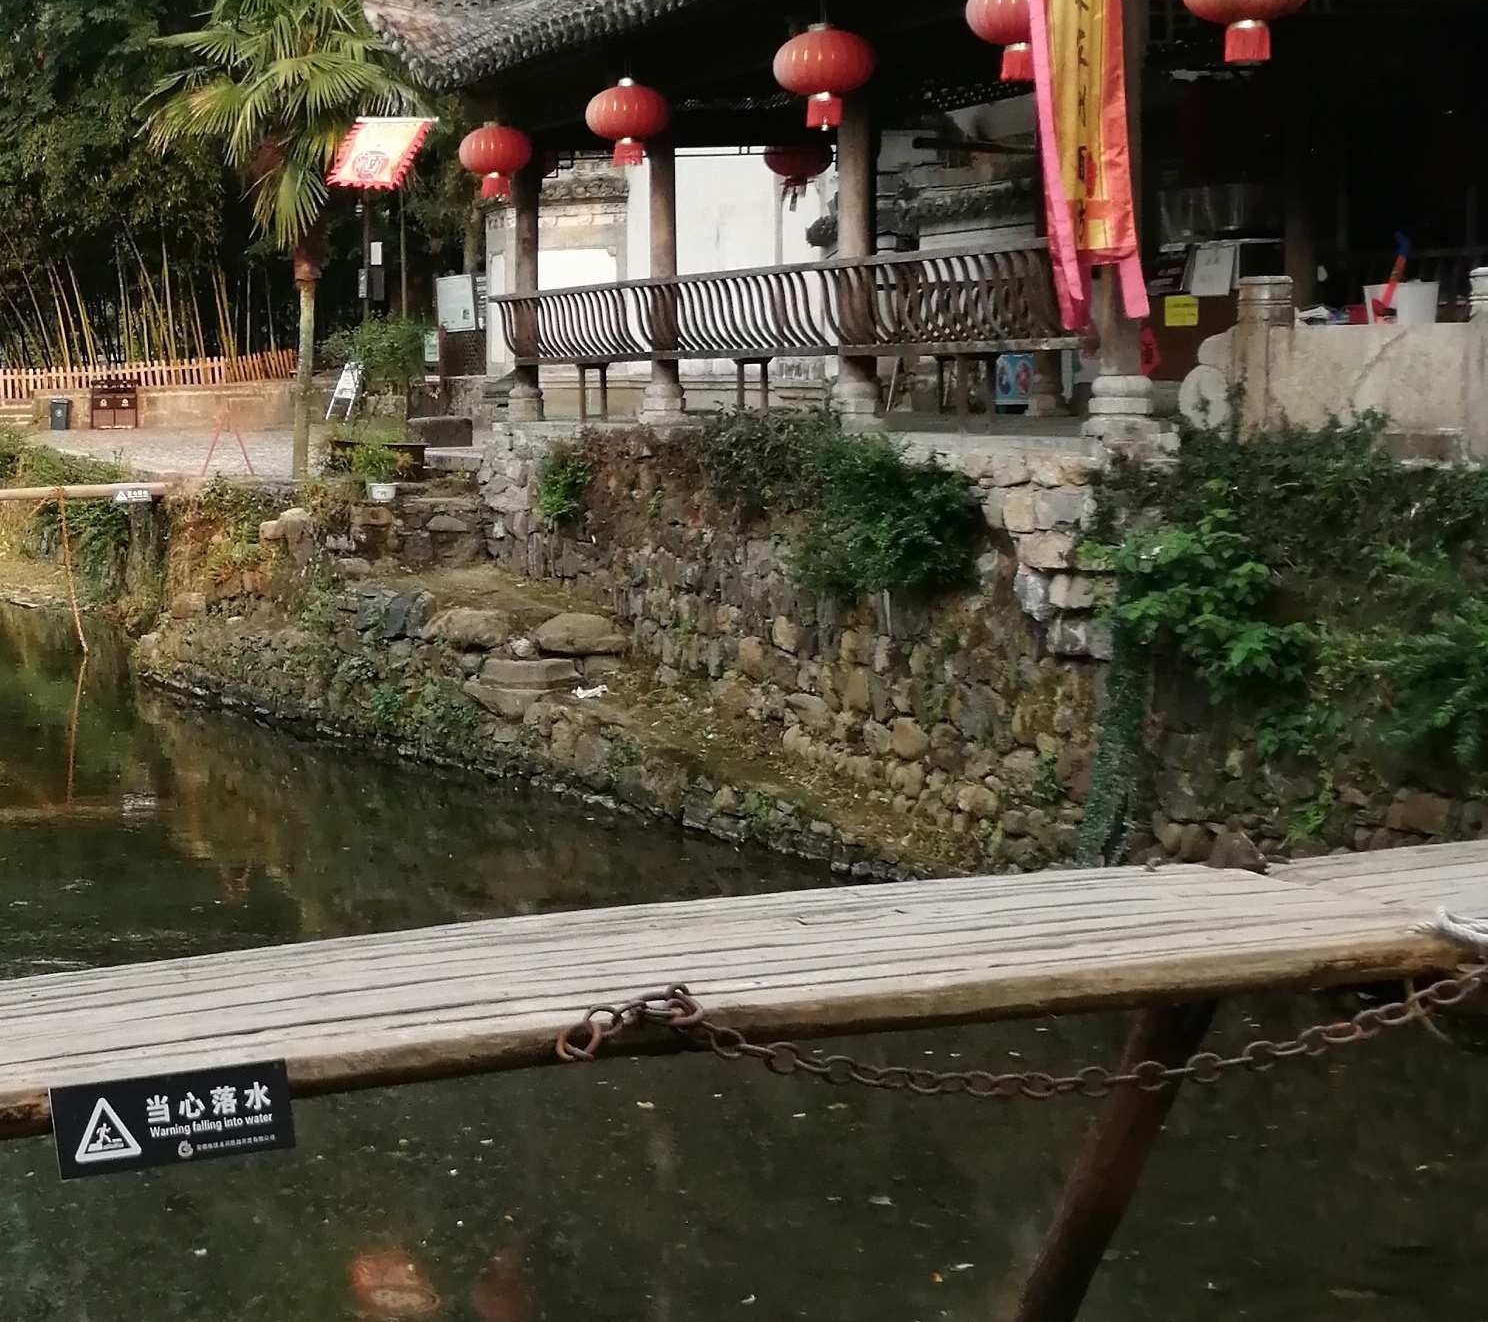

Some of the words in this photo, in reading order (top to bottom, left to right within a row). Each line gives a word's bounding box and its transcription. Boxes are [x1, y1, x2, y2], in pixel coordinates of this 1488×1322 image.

[146, 1081, 272, 1123] 当心落水
[149, 1123, 192, 1138] Warning
[192, 1119, 223, 1132] falling
[224, 1116, 243, 1128] into
[244, 1113, 273, 1125] water
